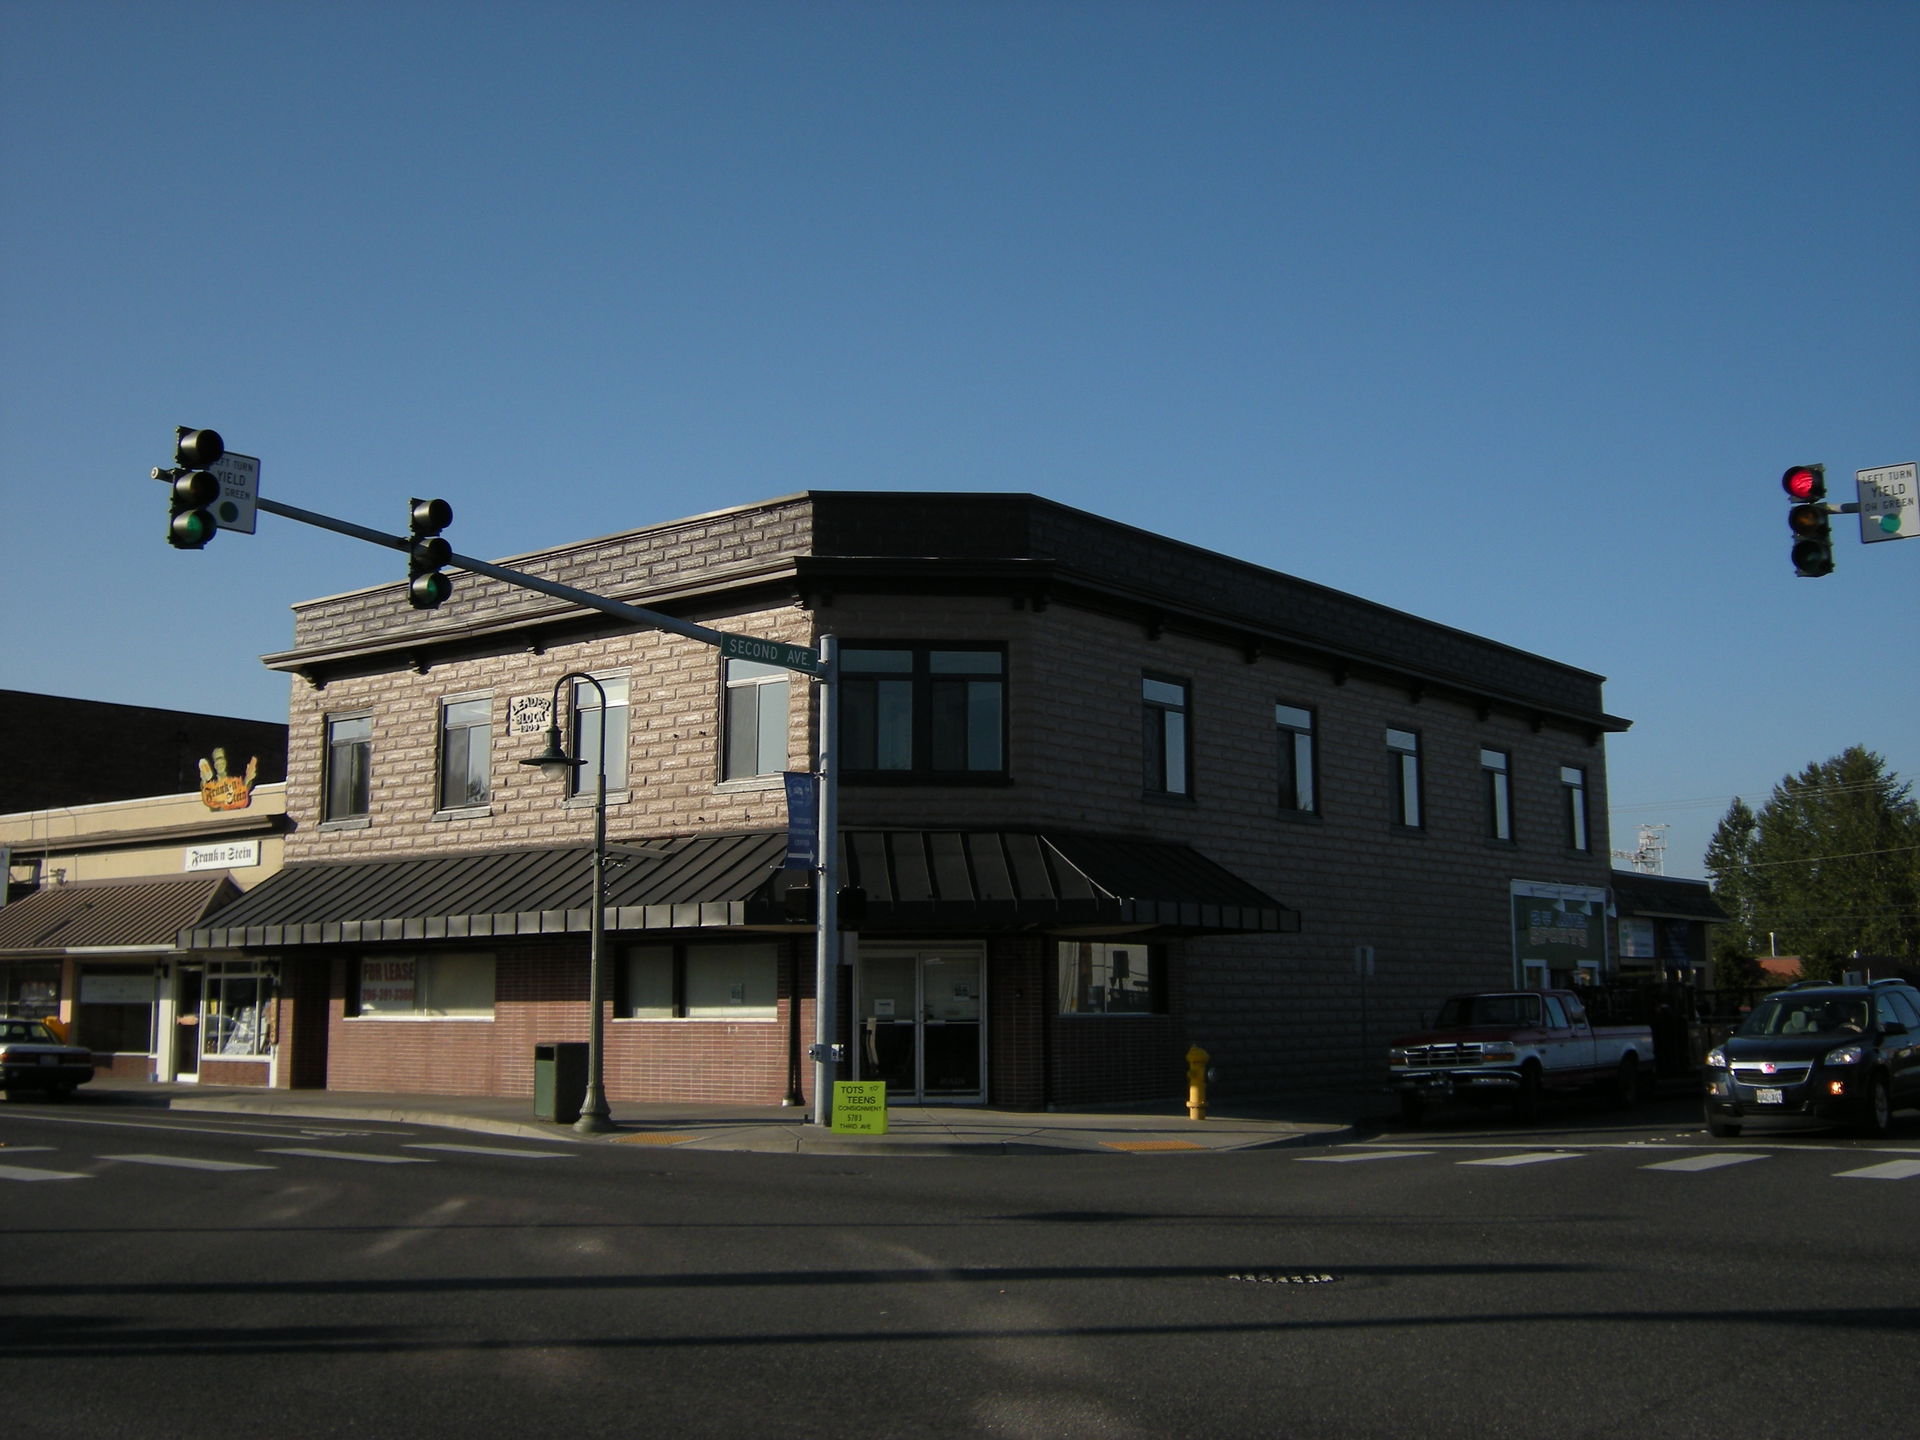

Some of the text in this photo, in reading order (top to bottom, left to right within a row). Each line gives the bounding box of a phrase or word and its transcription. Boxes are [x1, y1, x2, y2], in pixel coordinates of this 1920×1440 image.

[233, 461, 253, 472] TURN
[217, 470, 246, 486] YIELD
[1862, 470, 1912, 484] LEFT TURN
[1872, 484, 1906, 498] YIELD
[1864, 498, 1914, 512] ON GREEN
[729, 639, 778, 660] SECOND
[227, 847, 251, 860] Stein
[363, 962, 414, 981] FOR LEASE
[841, 1086, 864, 1094] TOTS
[847, 1096, 876, 1104] TEENS
